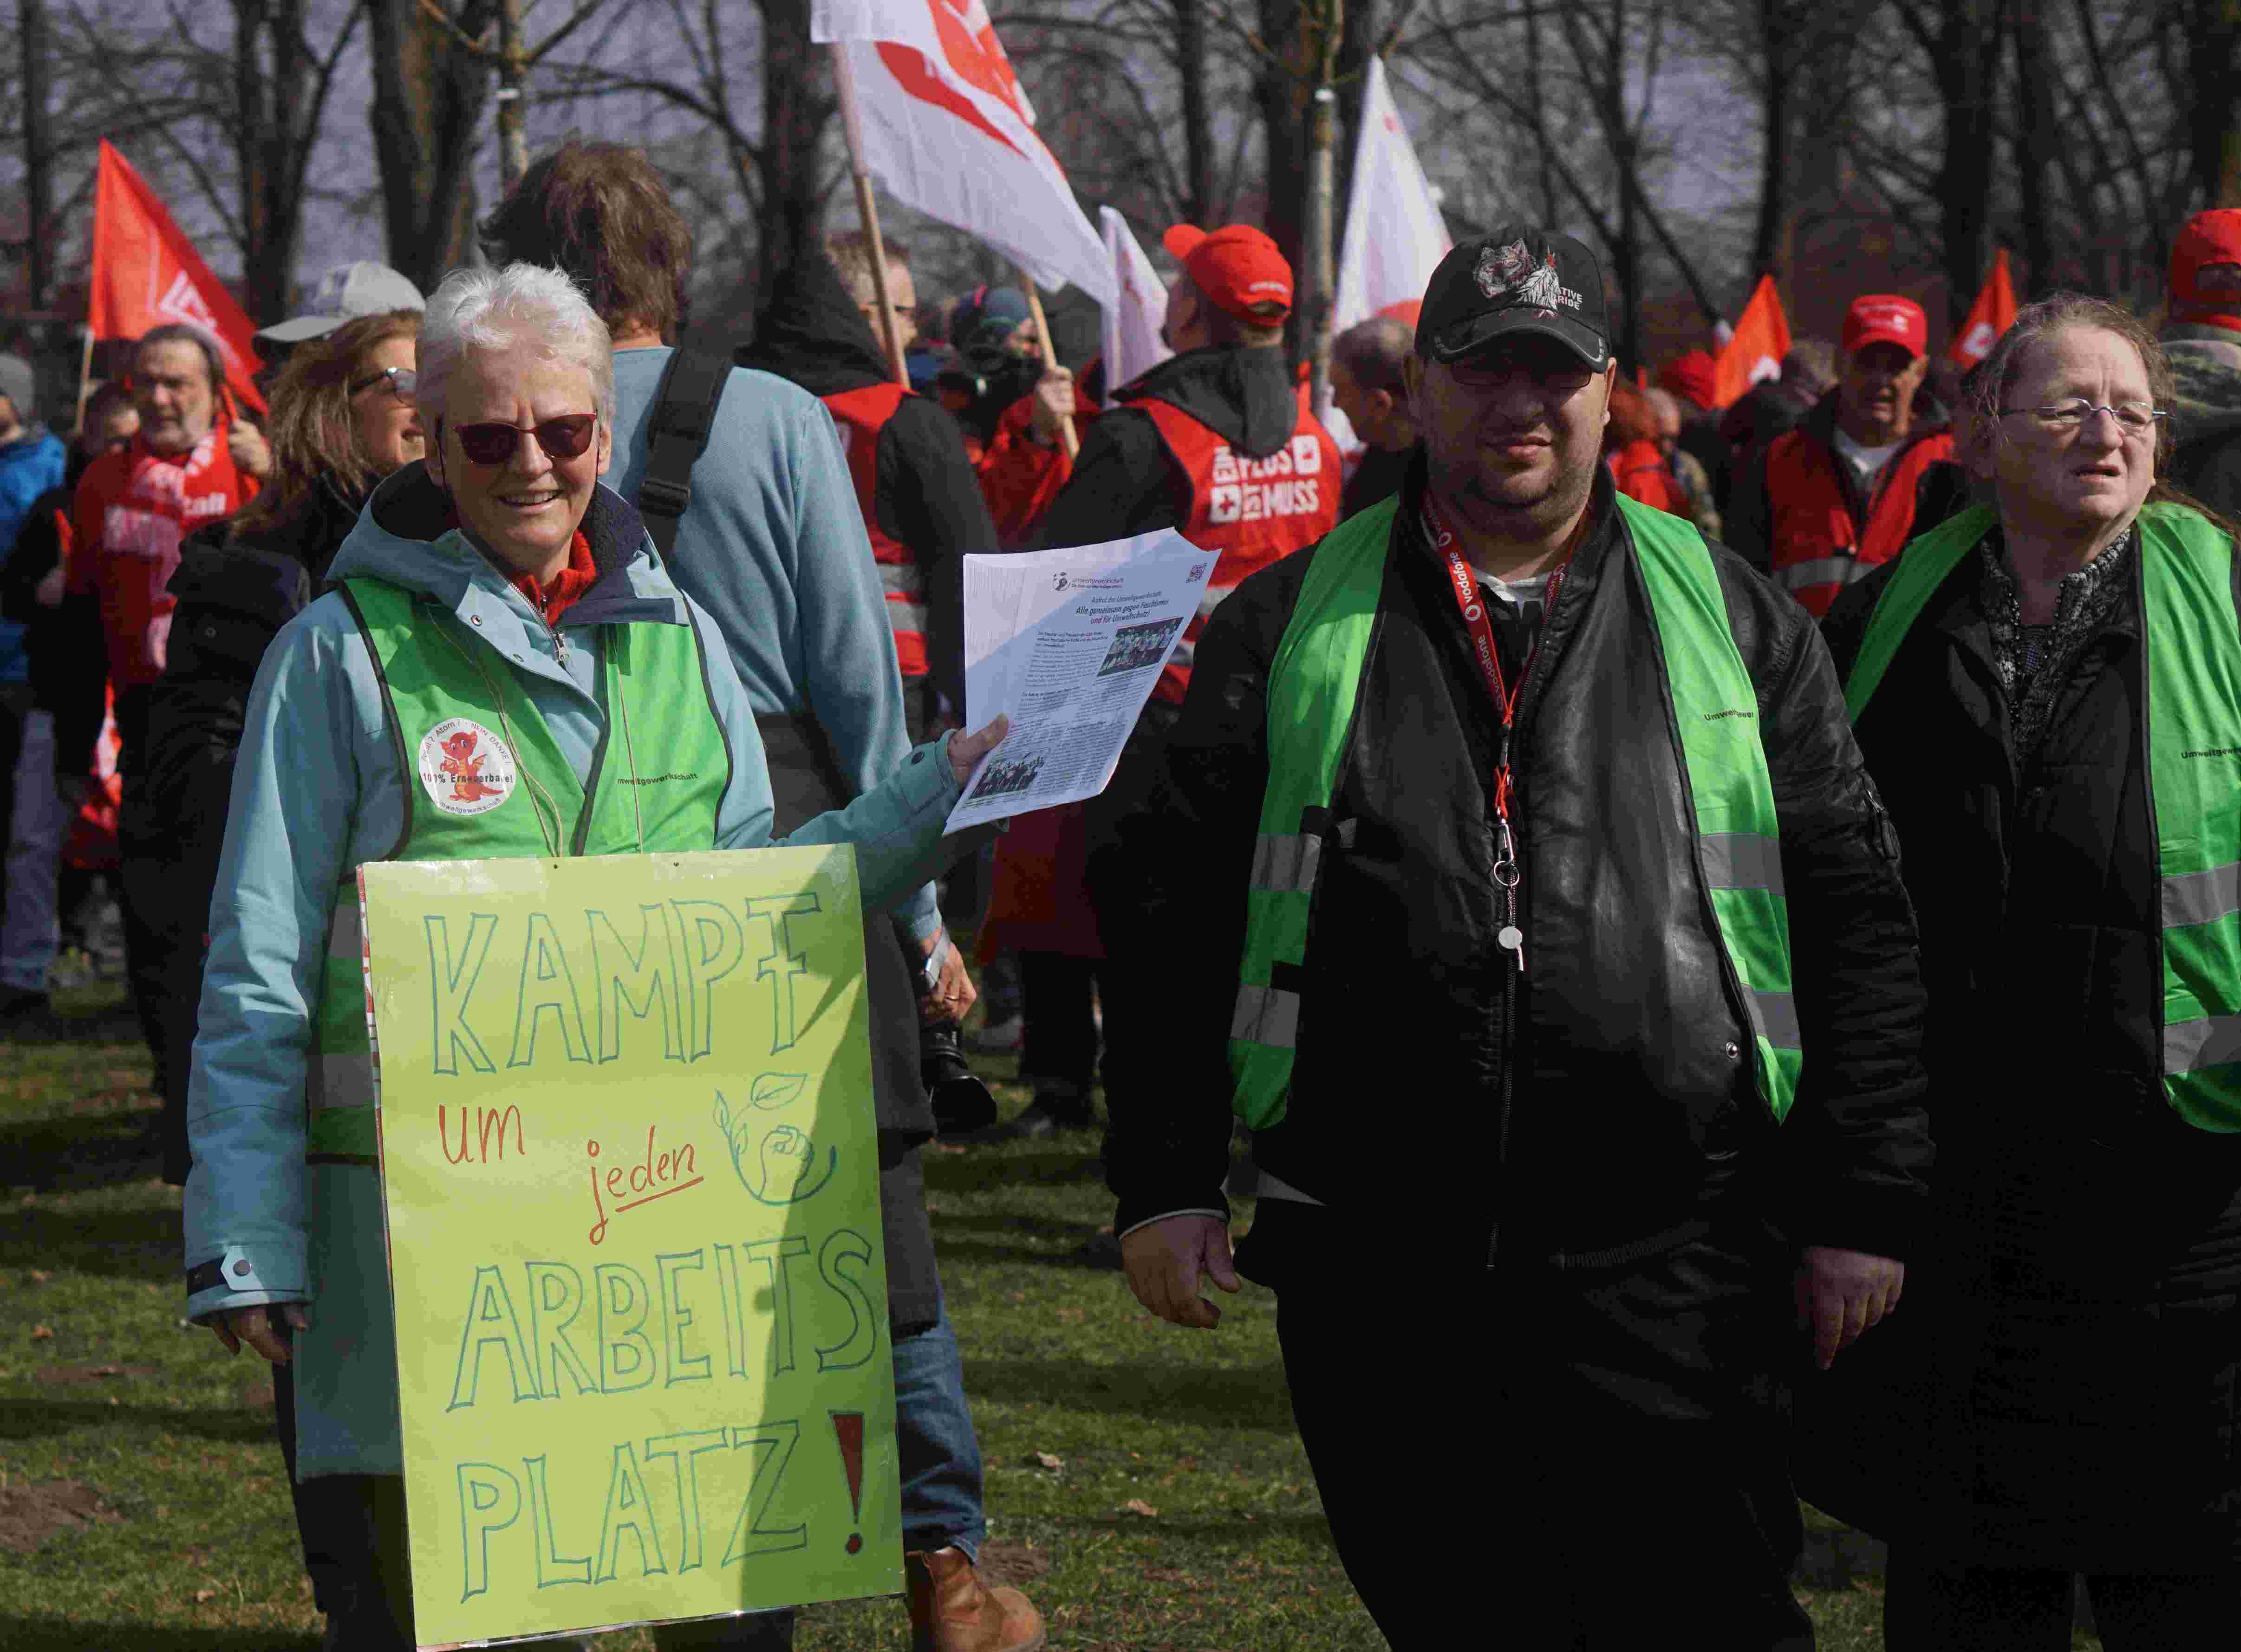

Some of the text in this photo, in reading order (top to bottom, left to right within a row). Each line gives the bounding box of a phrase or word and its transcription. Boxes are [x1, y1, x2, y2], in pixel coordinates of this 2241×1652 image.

[1449, 552, 1473, 604] vodafone
[1076, 605, 1088, 614] Alle
[1089, 606, 1121, 616] gemeinsam
[1122, 604, 1140, 613] gegen
[1091, 616, 1102, 624] und
[435, 722, 456, 736] Atom
[471, 723, 488, 736] NEIN
[489, 736, 509, 760] DANKE
[587, 1125, 696, 1246] jeden
[446, 1229, 877, 1412] ARBEITS
